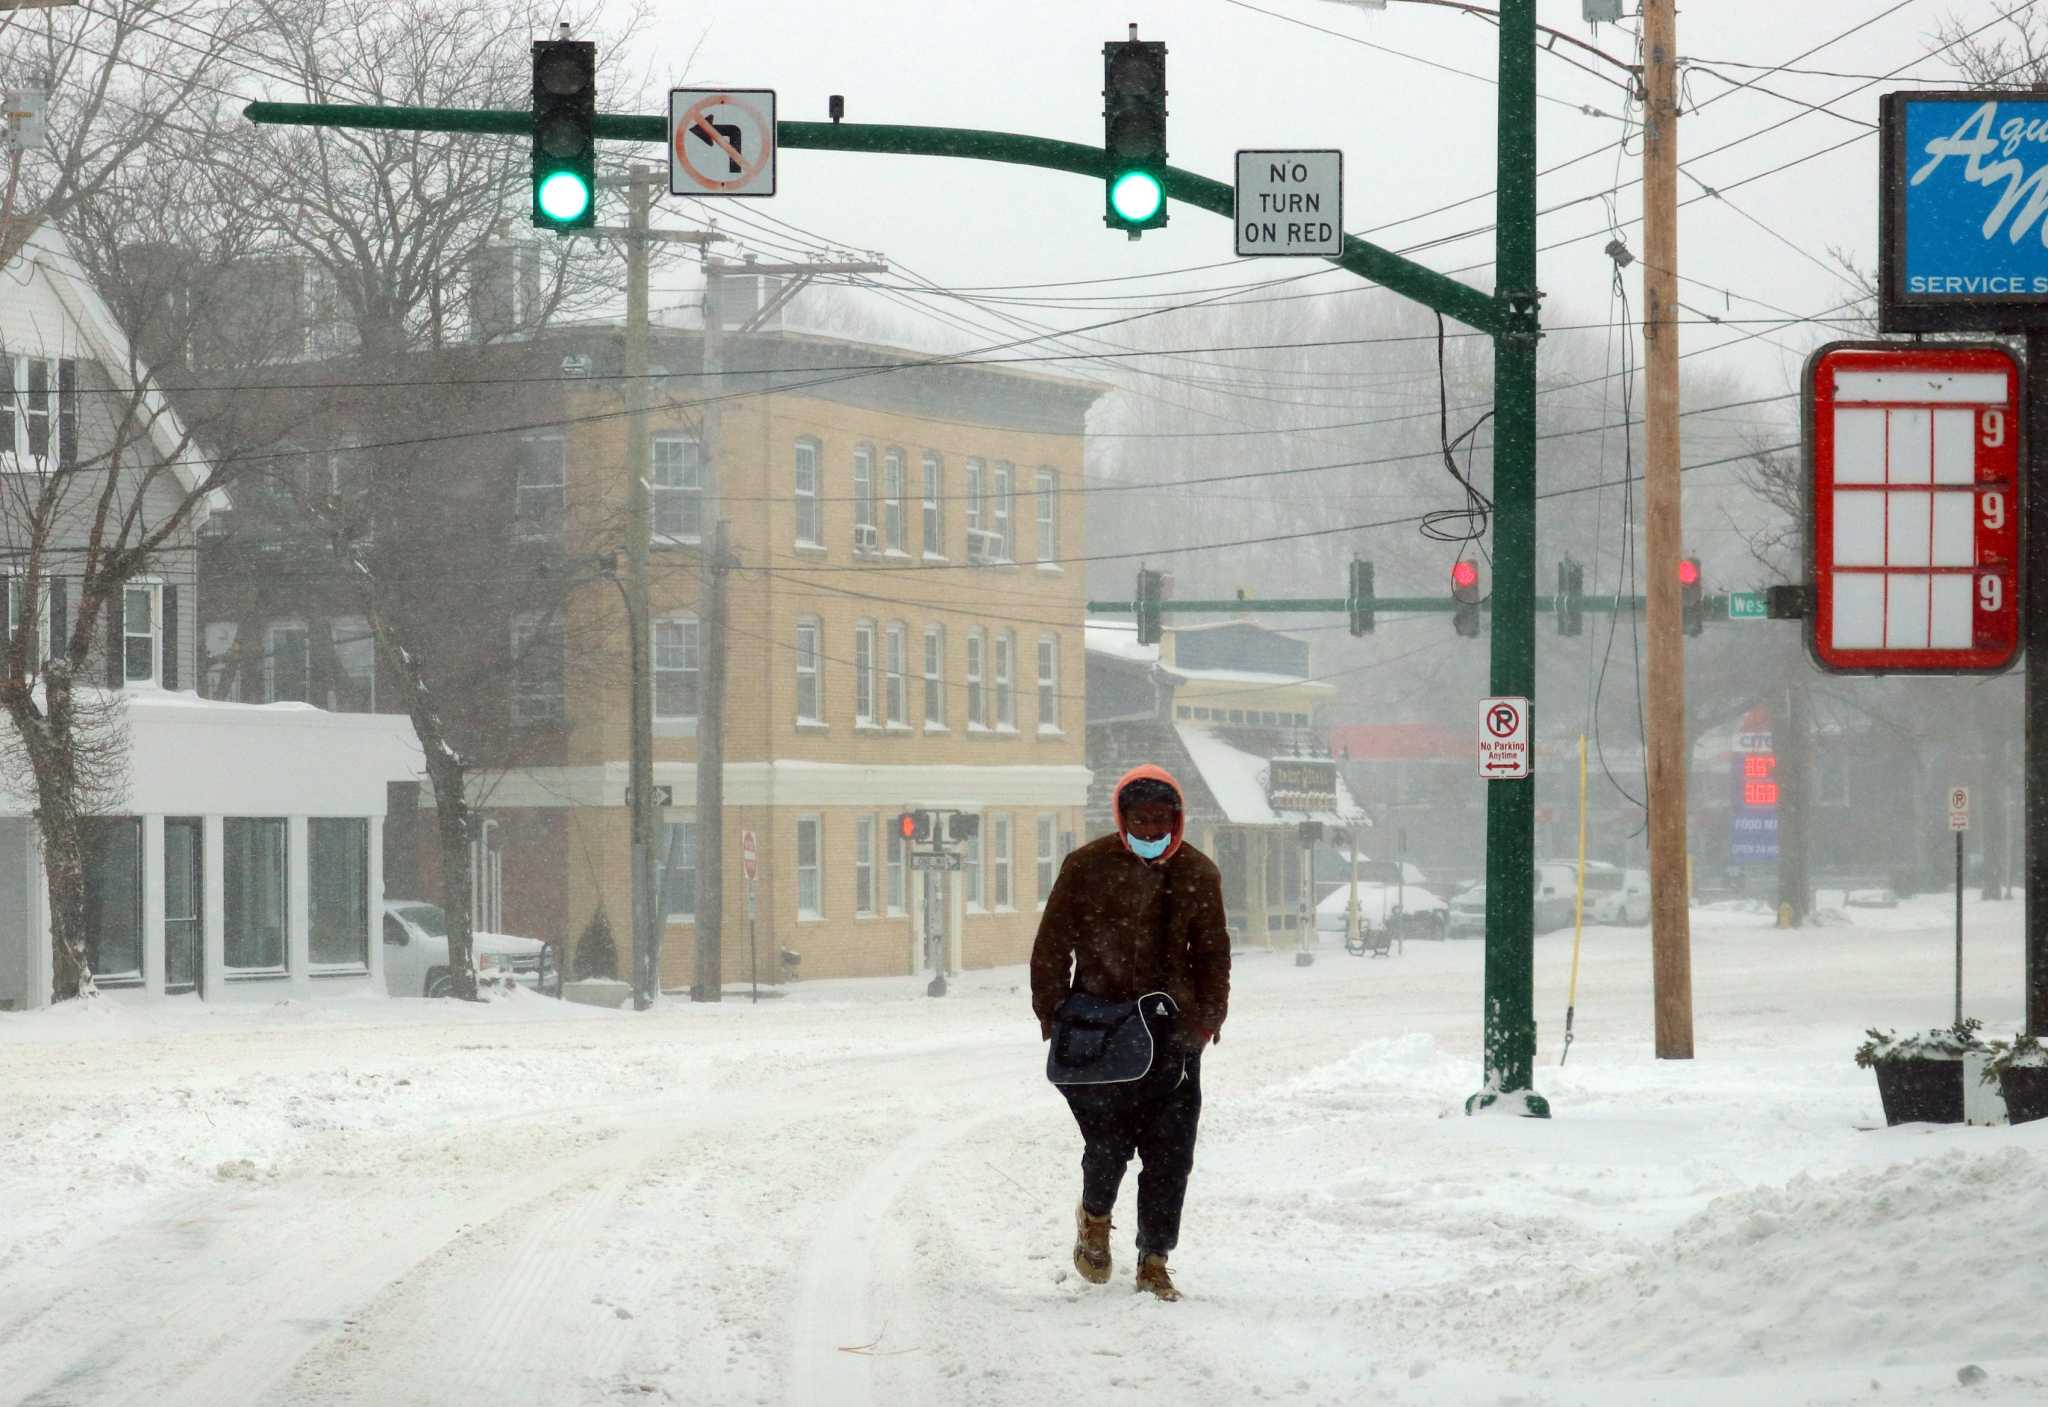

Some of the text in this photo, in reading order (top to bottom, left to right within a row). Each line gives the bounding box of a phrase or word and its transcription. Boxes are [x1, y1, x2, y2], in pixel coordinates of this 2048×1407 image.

[1270, 164, 1307, 183] NO
[1259, 193, 1320, 213] TURN
[1245, 223, 1332, 242] ON RED
[1911, 276, 2026, 293] SERVICE
[1982, 410, 2005, 448] 9
[1982, 492, 2005, 529] 9
[1980, 574, 2003, 611] 9
[1480, 741, 1525, 752] No Parking
[1488, 751, 1517, 760] Anytime
